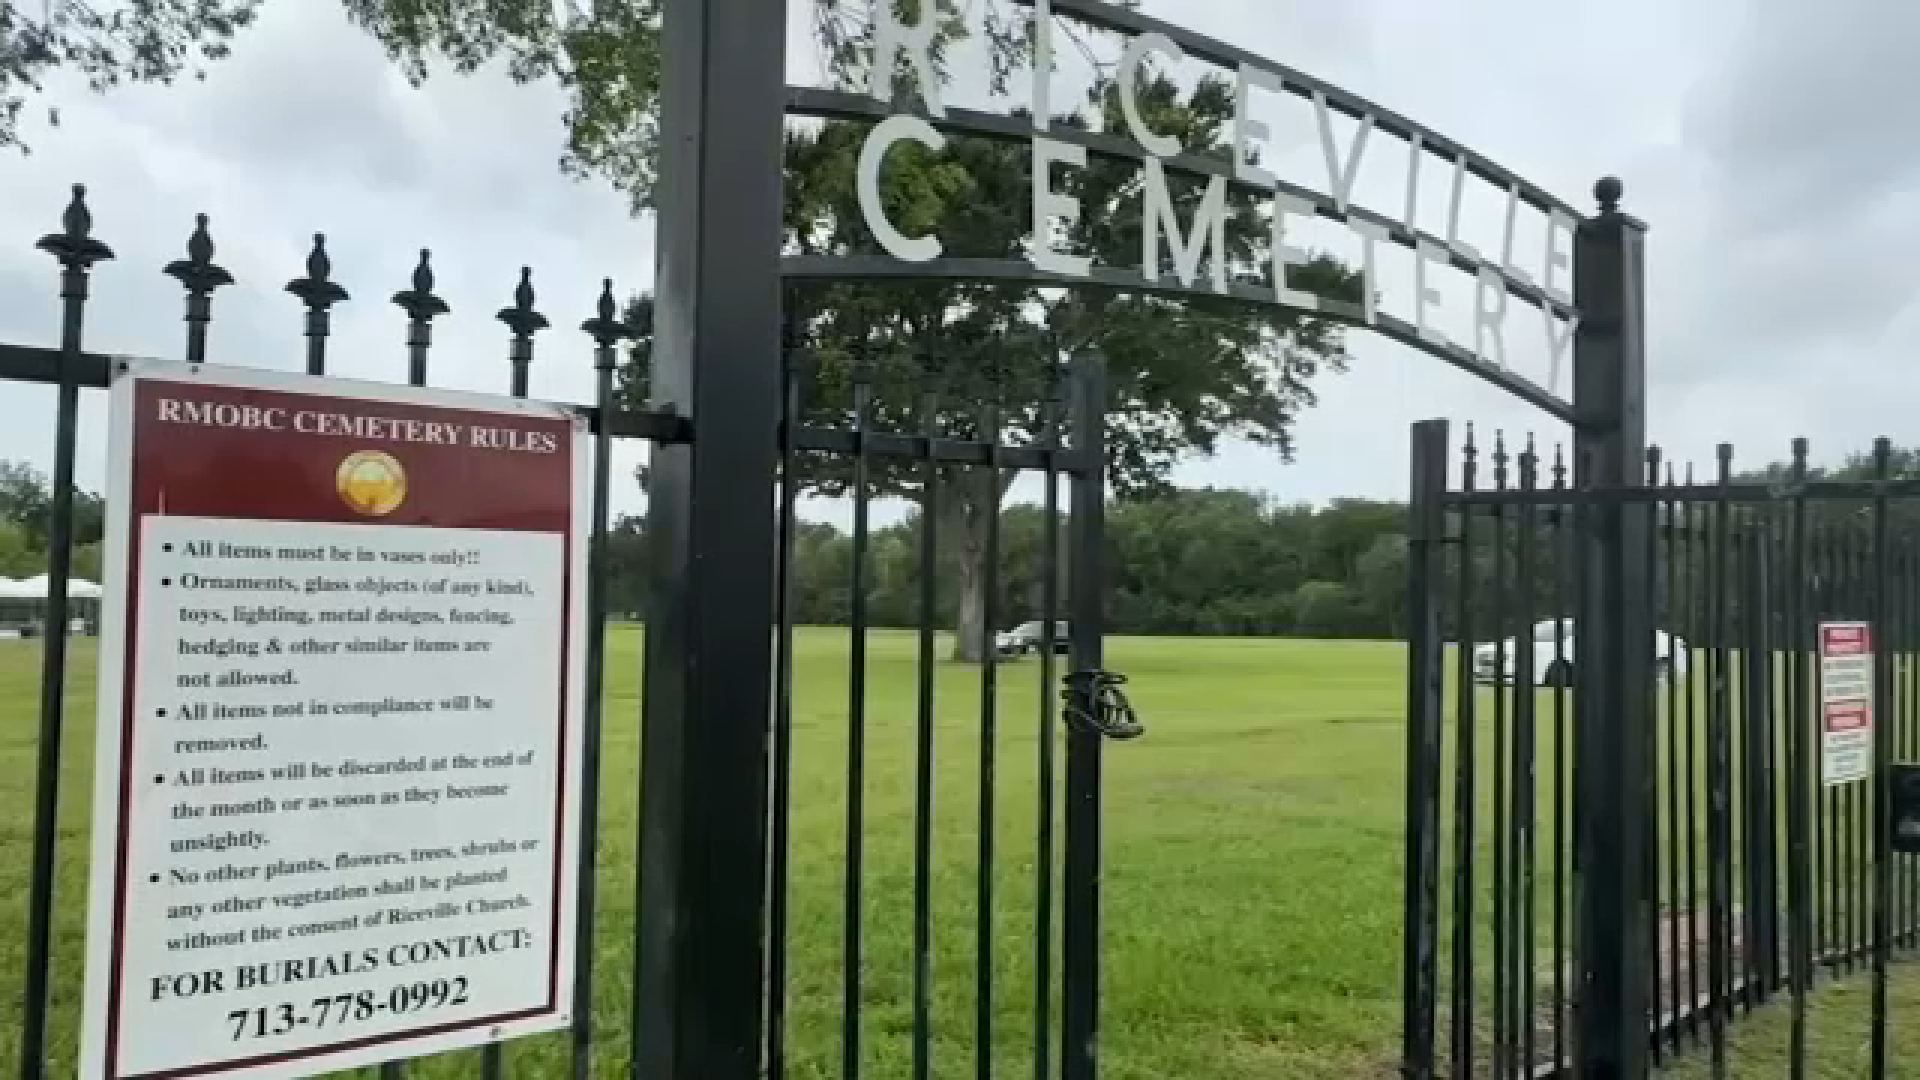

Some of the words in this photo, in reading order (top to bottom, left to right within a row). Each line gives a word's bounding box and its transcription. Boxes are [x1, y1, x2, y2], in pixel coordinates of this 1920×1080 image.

[857, 115, 1579, 394] CEMETERY
[157, 398, 285, 431] RMOBC
[294, 410, 463, 446] CEMETERY
[470, 426, 557, 453] RULES
[180, 540, 214, 559] All
[219, 542, 272, 560] items
[277, 545, 325, 562] must
[330, 546, 352, 561] be
[357, 546, 375, 562] in
[380, 549, 426, 563] vases
[179, 573, 300, 594] Ornaments,
[304, 577, 350, 596] glass
[355, 576, 418, 597] objects
[452, 581, 481, 598] any
[179, 607, 226, 624] toys,
[232, 606, 314, 625] lighting,
[318, 607, 370, 623] metal
[374, 607, 444, 626] designs,
[449, 608, 514, 626] fencing,
[178, 638, 259, 658] hedging
[265, 639, 283, 655] &
[288, 638, 339, 654] other
[344, 638, 408, 653] similar
[413, 638, 460, 652] items
[464, 641, 492, 652] are
[177, 672, 211, 687] not
[216, 669, 299, 687] allowed.
[174, 704, 208, 721] All
[212, 703, 266, 719] items
[271, 702, 304, 716] not
[309, 700, 327, 715] in
[332, 696, 434, 716] compliance
[439, 696, 472, 711] will
[475, 695, 493, 710] be
[173, 733, 269, 754] removed.
[172, 770, 205, 787] All
[209, 767, 264, 785] items
[270, 764, 306, 779] will
[311, 763, 334, 778] be
[338, 756, 427, 777] discarded
[431, 756, 448, 770] at
[452, 754, 479, 769] the
[482, 752, 514, 767] end
[517, 750, 534, 765] of
[170, 803, 204, 819] the
[209, 799, 276, 817] month
[281, 798, 303, 812] or
[308, 796, 328, 811] as
[333, 793, 376, 808] soon
[380, 791, 400, 806] as
[405, 786, 440, 806] they
[446, 782, 509, 800] become
[169, 829, 271, 854] unsightly.
[168, 869, 199, 886] No
[204, 863, 259, 882] other
[335, 852, 406, 871] flowers,
[461, 839, 517, 856] shrubs
[521, 839, 539, 851] or
[167, 904, 203, 921] any
[212, 896, 267, 915] other
[273, 884, 368, 910] vegetation
[373, 878, 415, 895] shall
[419, 875, 440, 890] be
[444, 867, 509, 892] planted
[167, 929, 246, 950] without
[252, 925, 282, 941] the
[287, 915, 358, 937] consent
[363, 912, 385, 926] of
[388, 904, 461, 926] Riceville
[150, 969, 225, 1001] FOR
[236, 947, 380, 989] BURIALS
[386, 928, 532, 967] CONTACT:
[227, 975, 471, 1042] 713-778-0992
